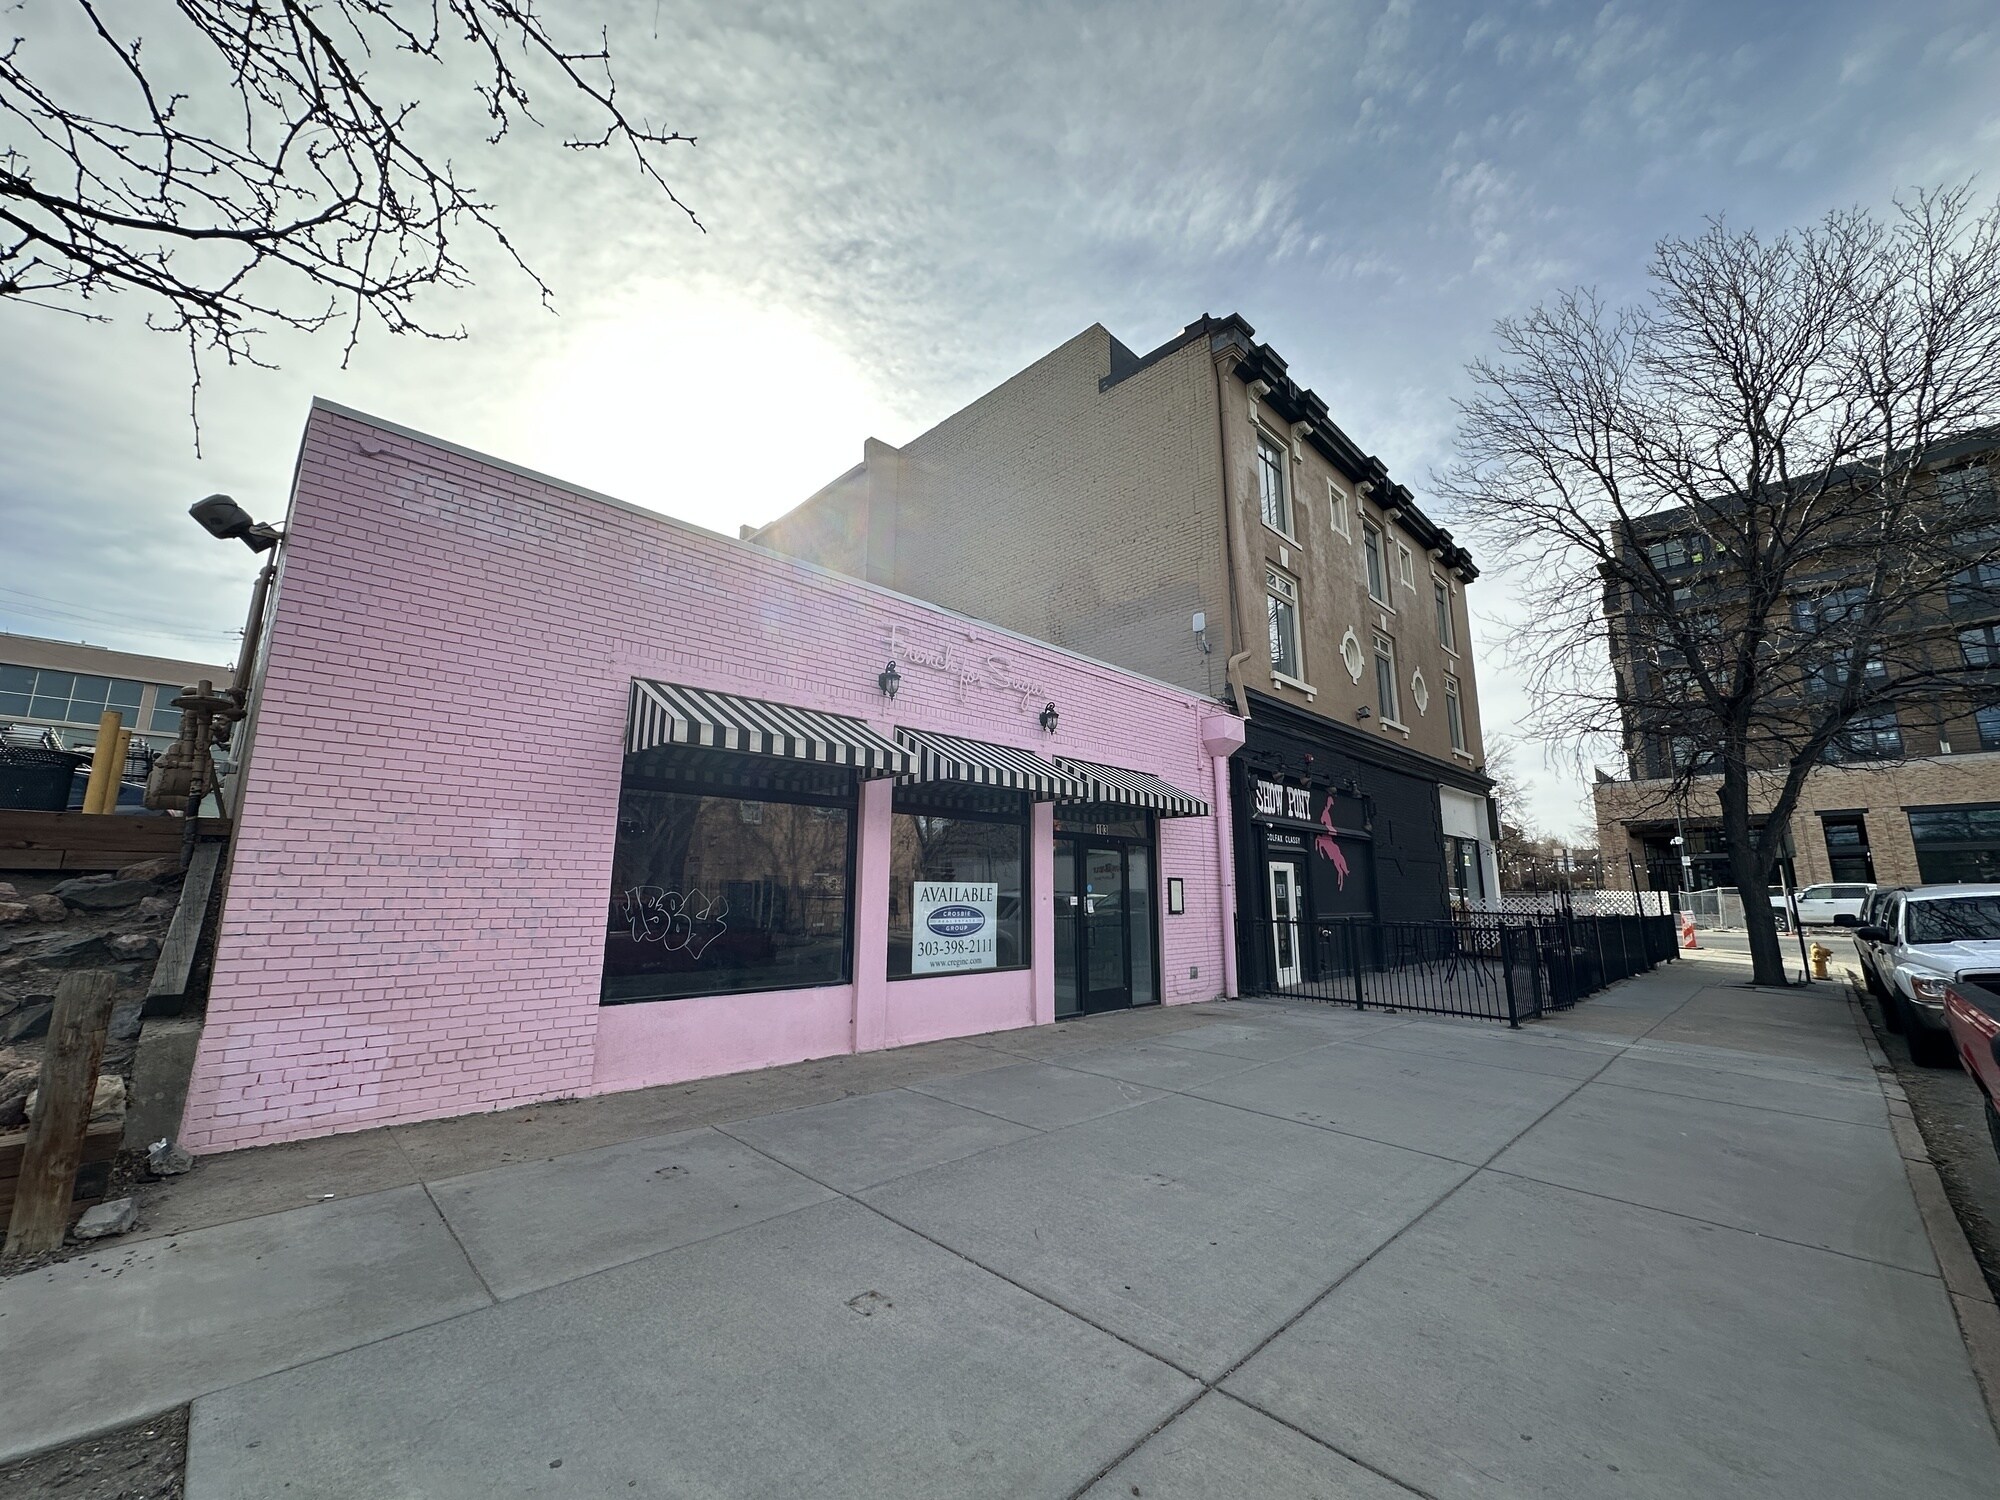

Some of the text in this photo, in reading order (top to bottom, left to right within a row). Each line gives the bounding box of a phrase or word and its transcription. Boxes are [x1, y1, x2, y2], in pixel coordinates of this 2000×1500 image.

[959, 656, 984, 703] for
[1256, 779, 1311, 820] SHOW PONY
[920, 886, 993, 902] AVAILABLE
[917, 938, 992, 957] 303-398-2111
